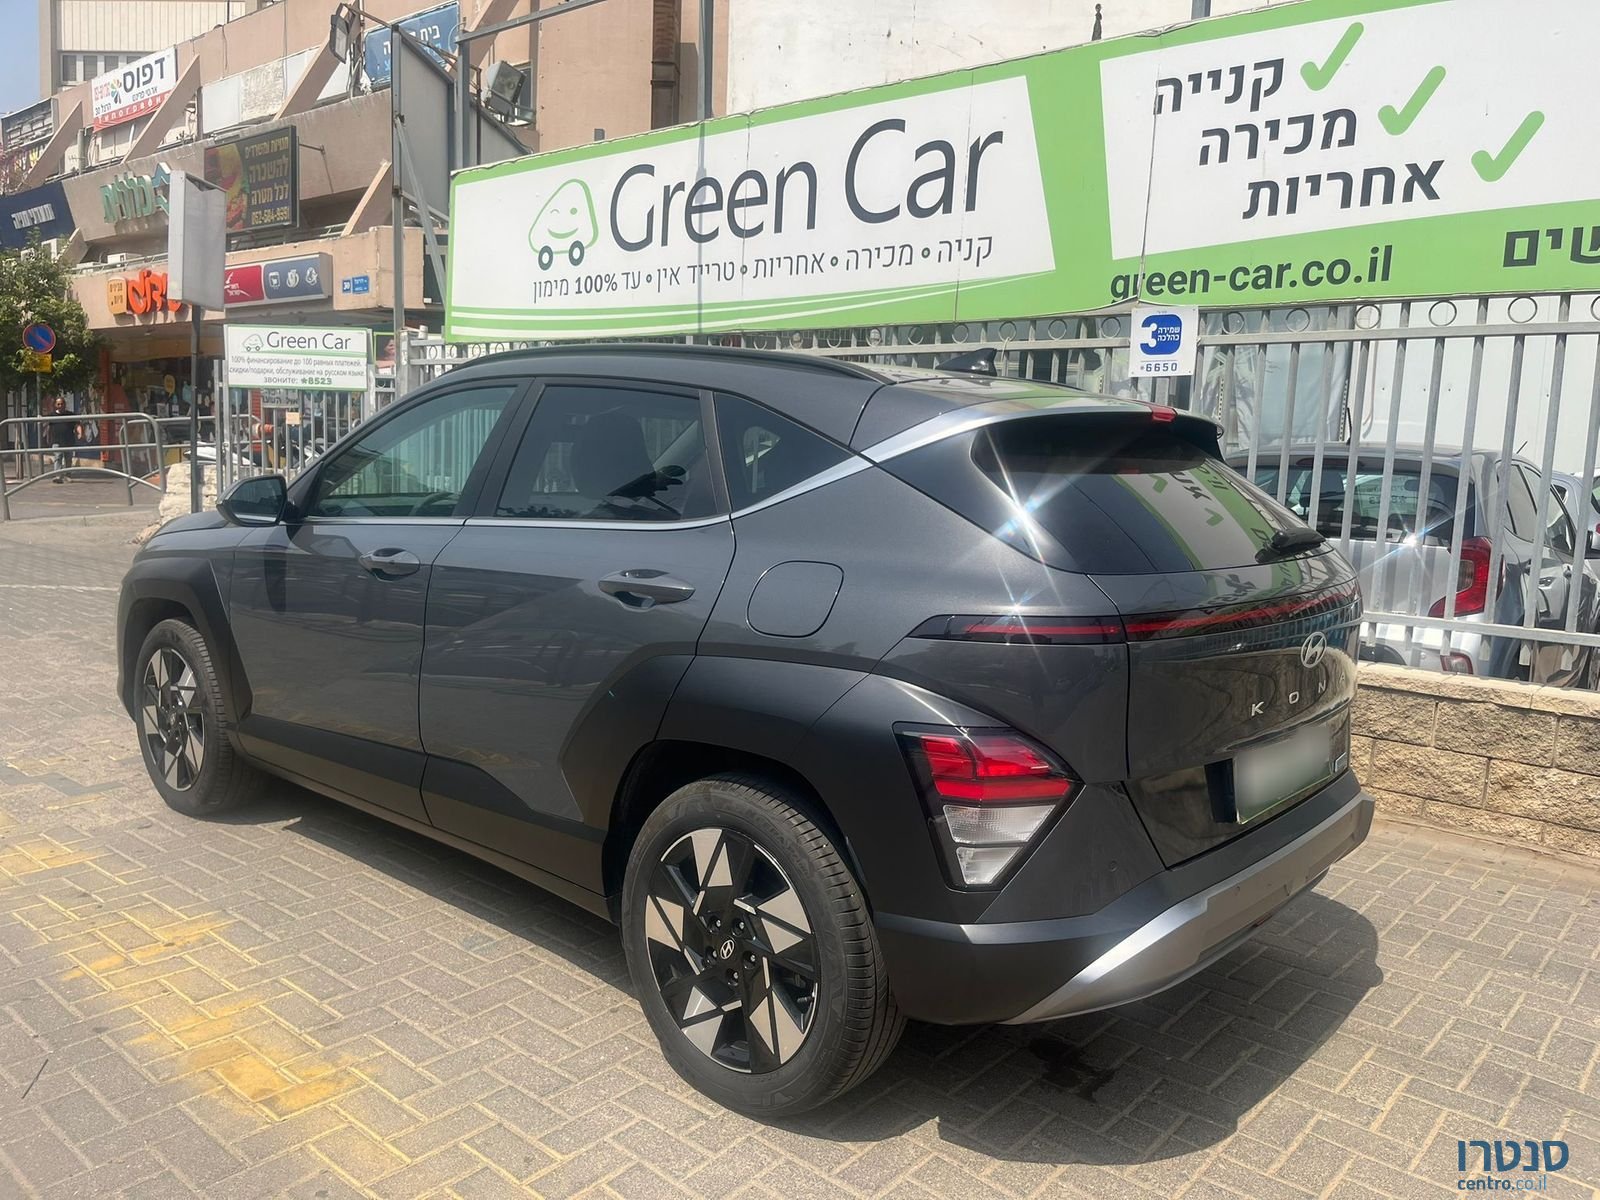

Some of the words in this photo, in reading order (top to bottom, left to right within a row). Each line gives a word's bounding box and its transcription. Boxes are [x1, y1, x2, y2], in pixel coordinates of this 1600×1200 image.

[123, 57, 166, 93] דפוס
[1154, 57, 1285, 115] קנייה
[1199, 108, 1357, 166] מכירה
[611, 161, 818, 252] Green
[845, 118, 1004, 224] Car
[1242, 160, 1445, 220] אחריות
[846, 243, 914, 271] מכירה
[937, 235, 993, 267] קניה
[687, 261, 735, 284] טרייד
[752, 252, 825, 279] אחריות
[1110, 245, 1393, 304] green-car.co.il
[533, 278, 569, 303] מימון
[574, 273, 618, 294] 100%
[621, 271, 641, 290] עד
[657, 266, 681, 293] אין
[266, 331, 318, 349] Green
[322, 333, 352, 350] Car
[1157, 326, 1181, 334] שמירה
[1157, 334, 1180, 342] כהלכה
